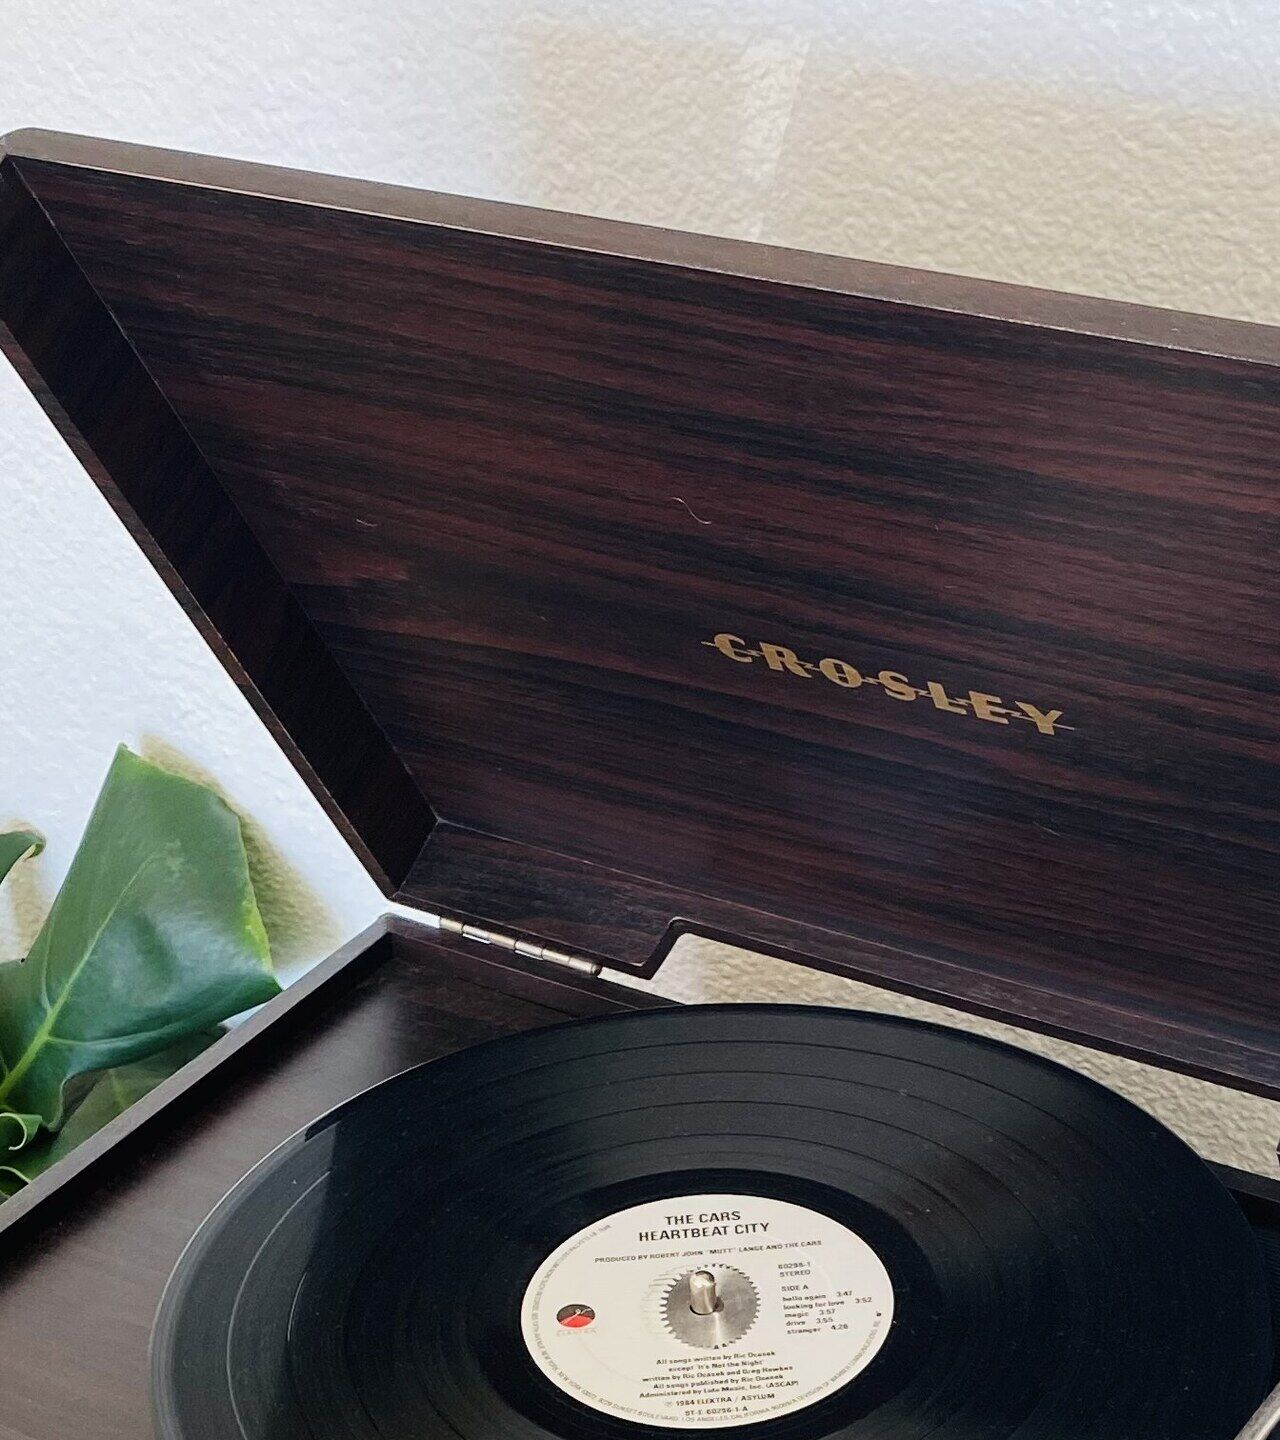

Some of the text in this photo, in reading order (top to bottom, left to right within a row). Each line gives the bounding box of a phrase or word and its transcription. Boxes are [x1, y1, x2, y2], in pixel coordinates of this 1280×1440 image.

[710, 633, 1066, 736] CROSLEY
[665, 1210, 741, 1226] THE CARS
[639, 1222, 770, 1242] HEARTBEAT CITY
[594, 1256, 636, 1264] PRODUCED
[739, 1245, 764, 1253] LANGE
[779, 1269, 811, 1277] STEREO
[694, 1355, 721, 1363] written
[642, 1375, 670, 1383] written
[672, 1374, 681, 1382] by
[690, 1378, 729, 1388] published
[639, 1389, 691, 1399] Administered
[693, 1388, 702, 1396] by
[765, 1380, 799, 1389] (ASCAP)
[676, 1399, 695, 1407] 1984
[696, 1396, 732, 1405] ELEKTRA
[740, 1393, 776, 1401] ASYLUM
